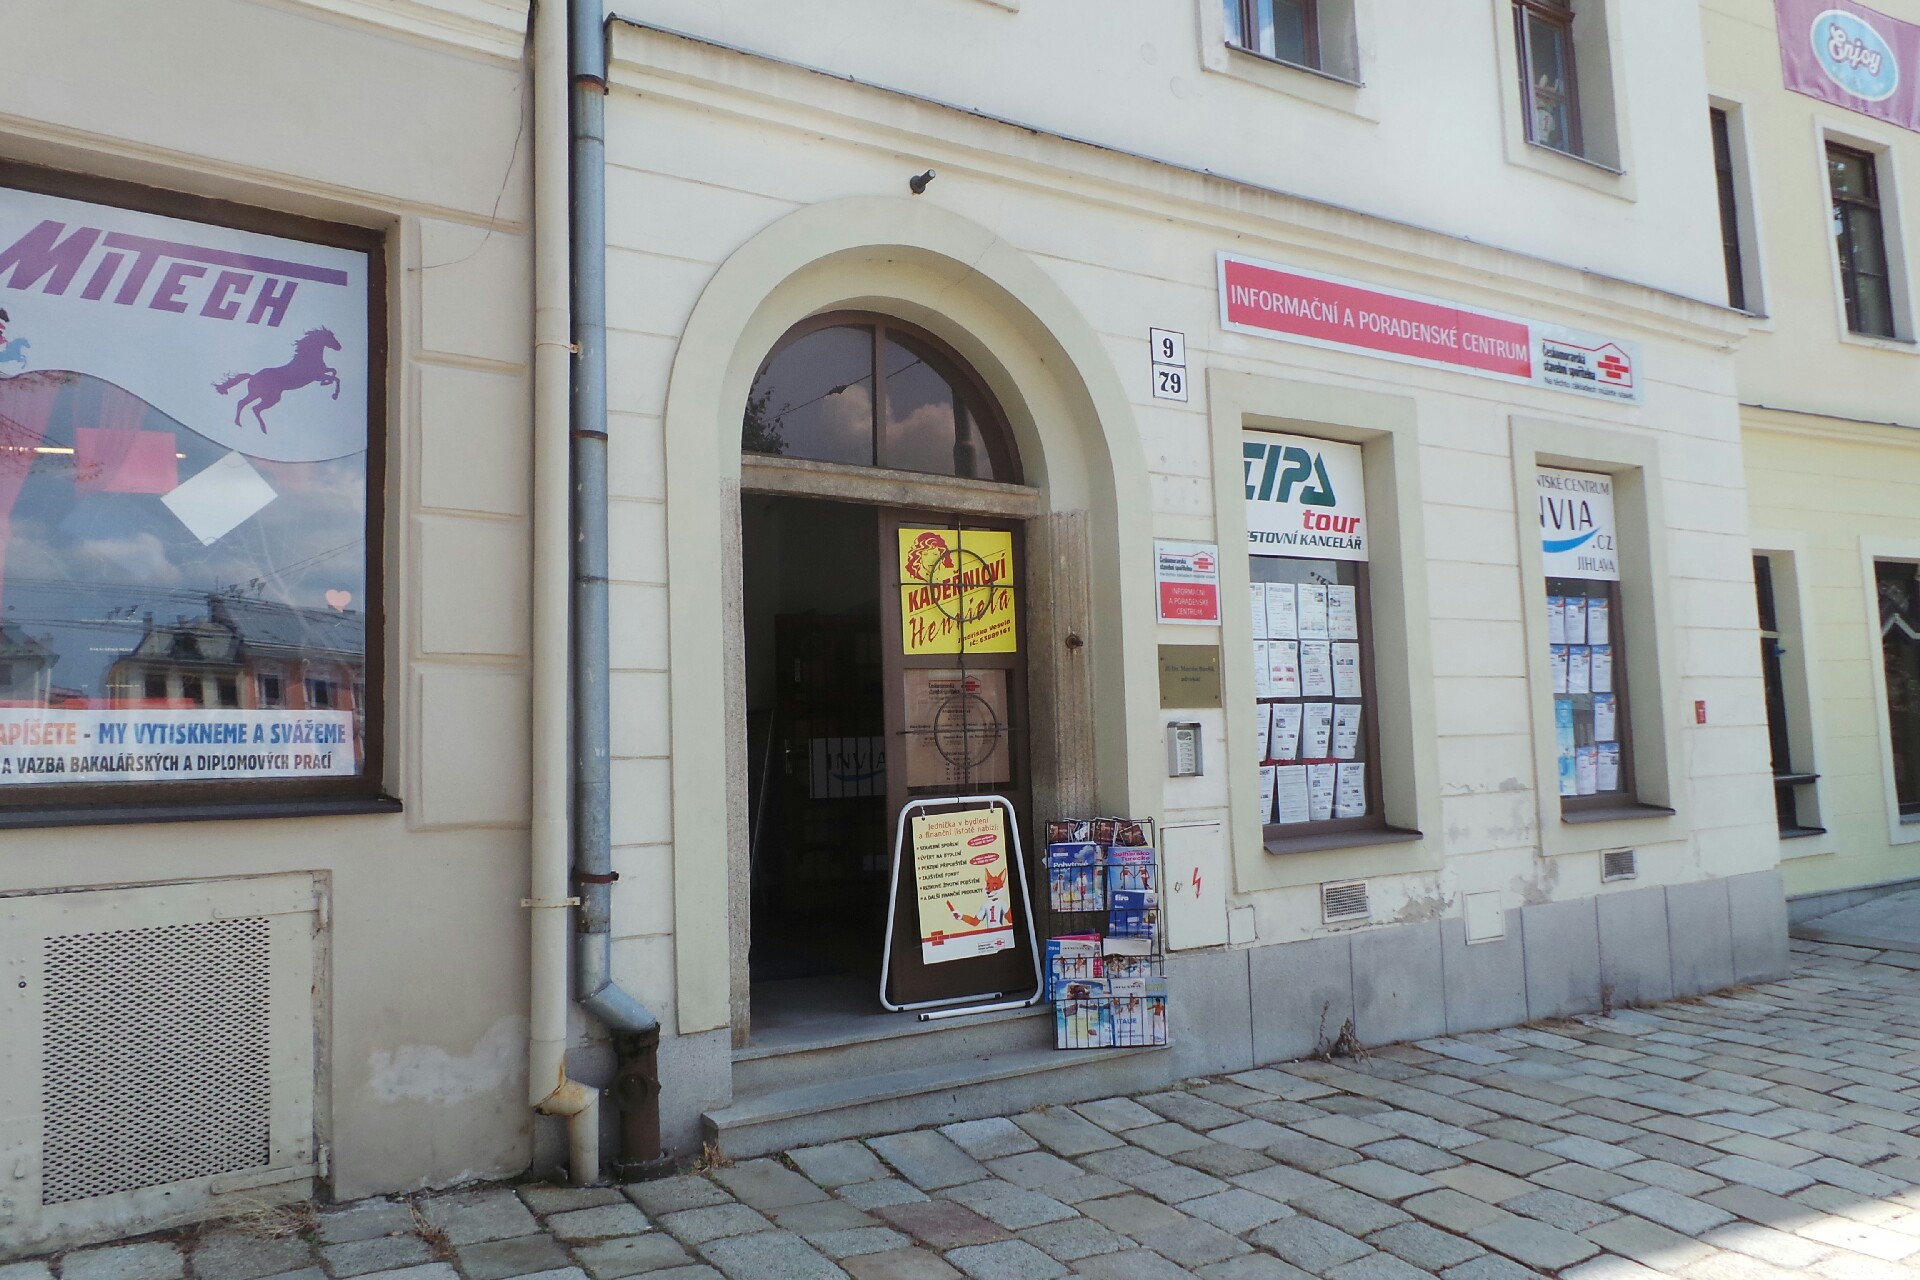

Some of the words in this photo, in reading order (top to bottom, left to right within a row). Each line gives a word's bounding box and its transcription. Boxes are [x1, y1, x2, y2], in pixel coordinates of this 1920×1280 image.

[1828, 23, 1881, 76] Enjoy
[1231, 284, 1339, 324] INFORMAČNÍ
[1343, 308, 1355, 328] A
[1359, 311, 1459, 349] PORADENSKÉ
[1462, 332, 1528, 362] CENTRUM
[1163, 338, 1174, 358] 9
[1159, 371, 1181, 393] 79
[1564, 478, 1609, 495] CENTRUM
[1303, 509, 1361, 533] tour
[1300, 535, 1361, 550] KANCELÁŘ
[1577, 556, 1615, 572] JIHLAVA
[1176, 607, 1203, 616] CENTRUM
[99, 723, 128, 745] MY
[134, 722, 247, 745] VYTISKNEME
[253, 723, 265, 744] A
[270, 720, 346, 744] SVÁŽEME
[2, 757, 12, 774] A
[17, 756, 65, 774] VAZBA
[70, 753, 178, 773] BAKALÁŘSKÝCH
[183, 755, 193, 771] A
[197, 752, 289, 771] DIPLOMOVÝCH
[294, 751, 332, 770] PRACÍ
[925, 829, 952, 838] finanční
[928, 820, 956, 831] Jednička
[964, 817, 989, 827] bydlení
